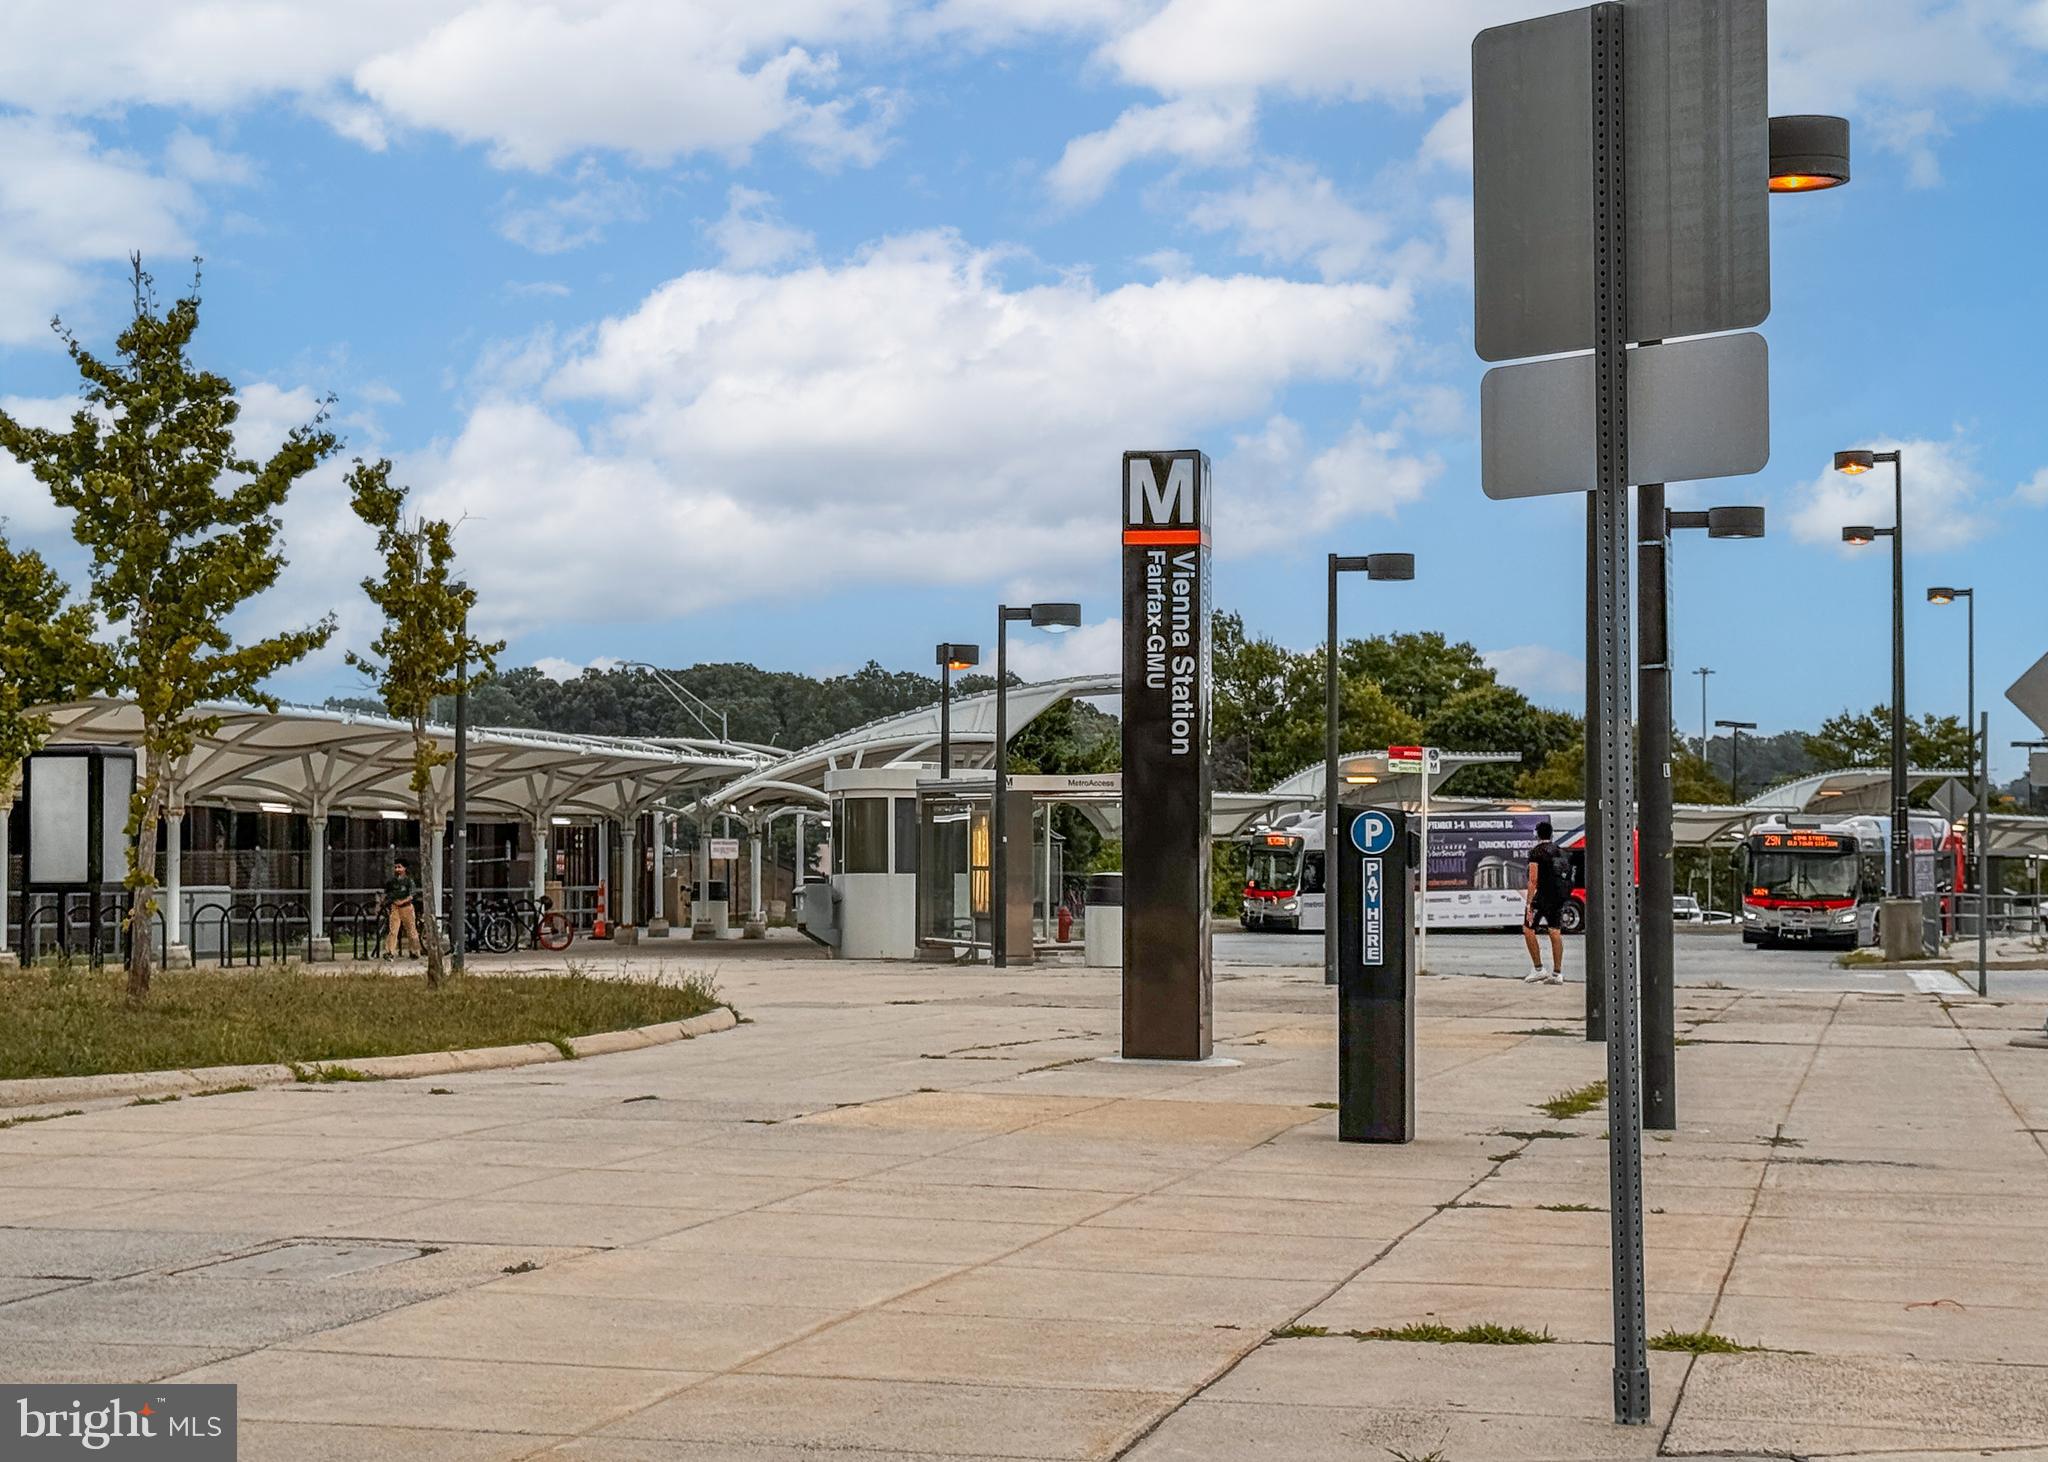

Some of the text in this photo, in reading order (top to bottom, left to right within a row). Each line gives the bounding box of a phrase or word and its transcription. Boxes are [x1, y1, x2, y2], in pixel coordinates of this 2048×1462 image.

[1129, 458, 1194, 525] M
[1146, 551, 1167, 689] Fairfax-GMU
[1171, 551, 1196, 755] Vienna Station
[1430, 762, 1438, 770] M
[1067, 779, 1115, 787] MetroAccess
[1365, 819, 1383, 847] P
[1428, 820, 1453, 830] PTEMBER
[1469, 820, 1504, 829] WASHINGTON
[1427, 850, 1466, 858] yberSecurity
[1367, 862, 1379, 960] PAY HERE
